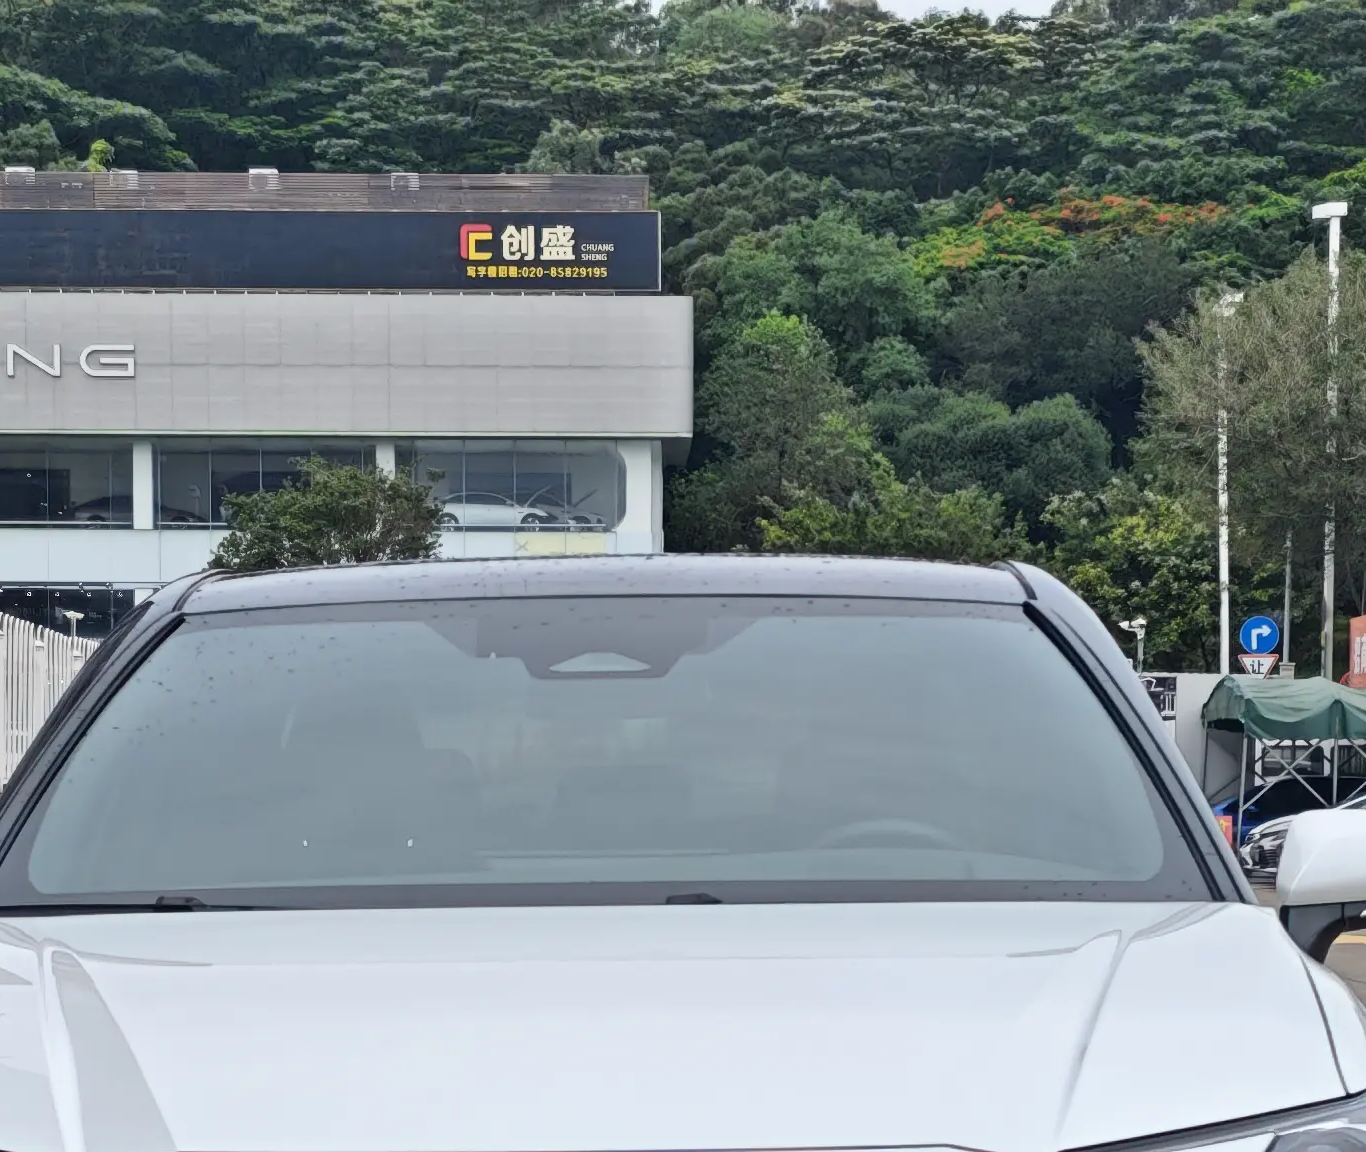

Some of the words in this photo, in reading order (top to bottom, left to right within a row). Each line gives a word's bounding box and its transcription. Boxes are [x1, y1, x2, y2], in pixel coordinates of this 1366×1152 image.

[501, 224, 576, 261] 创盛
[581, 243, 615, 252] CHUANG
[581, 253, 608, 261] SHENG
[1249, 660, 1265, 675] 让
